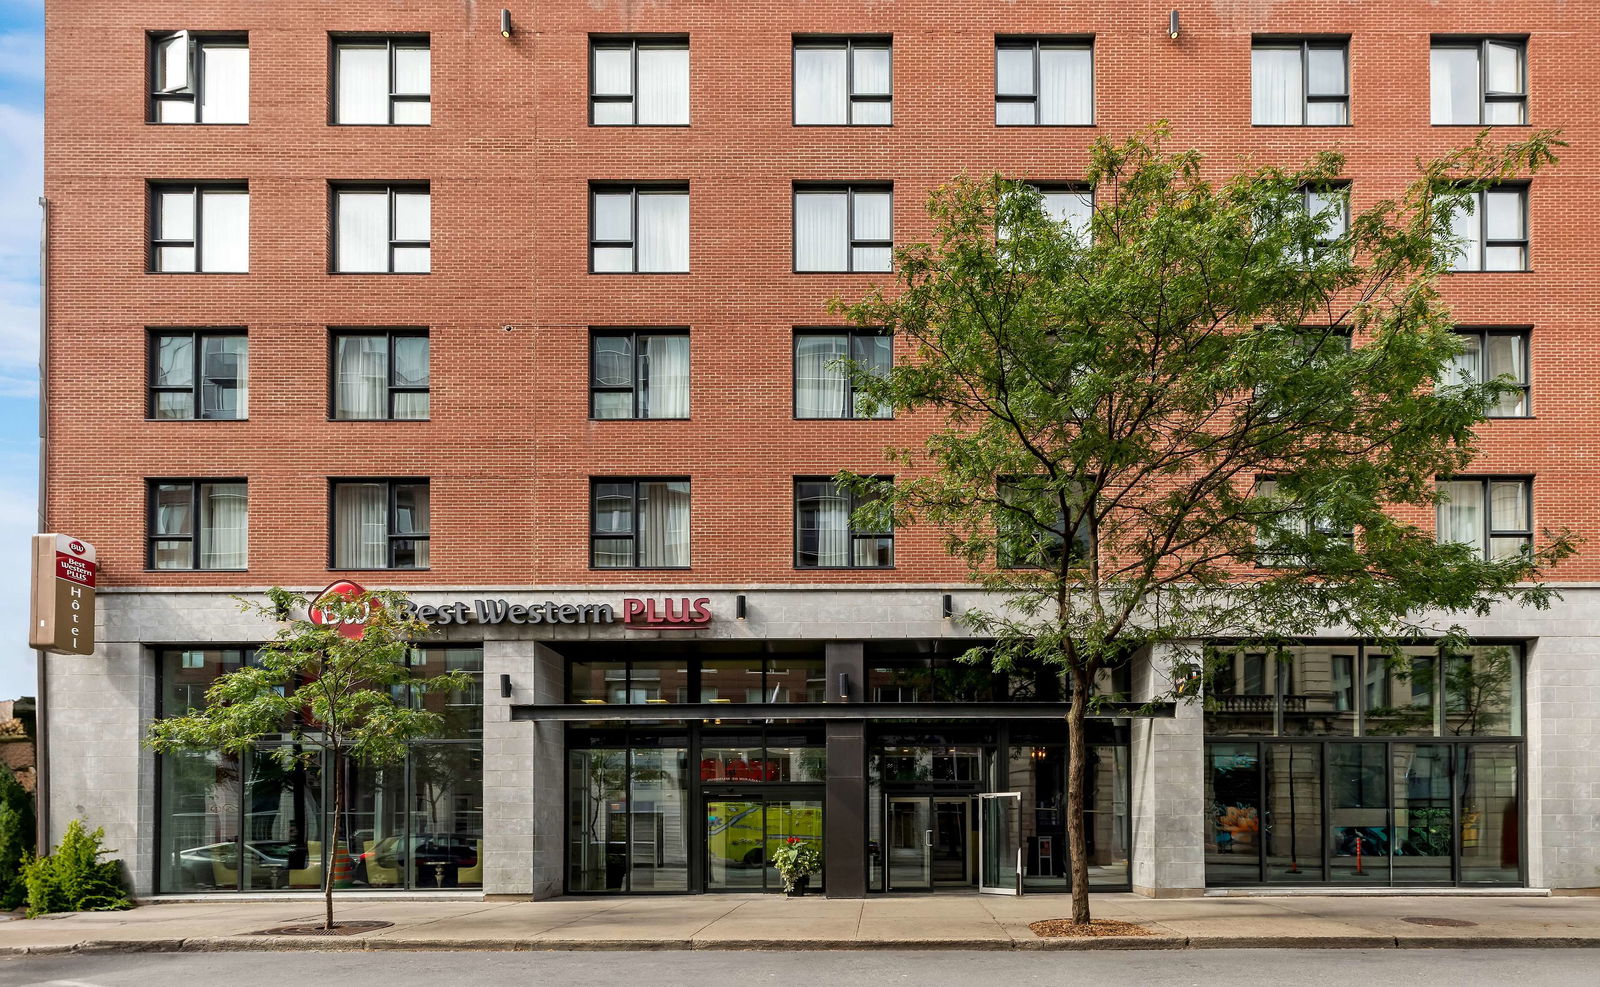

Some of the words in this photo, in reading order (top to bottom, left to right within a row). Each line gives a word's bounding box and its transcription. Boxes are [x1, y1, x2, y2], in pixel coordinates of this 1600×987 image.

[71, 544, 84, 552] BW
[61, 561, 92, 577] Western
[68, 558, 86, 569] Best
[67, 570, 87, 581] PLUS
[71, 586, 81, 648] Hôtel
[394, 599, 471, 625] Best
[474, 599, 614, 625] Western
[623, 597, 712, 624] PLUS
